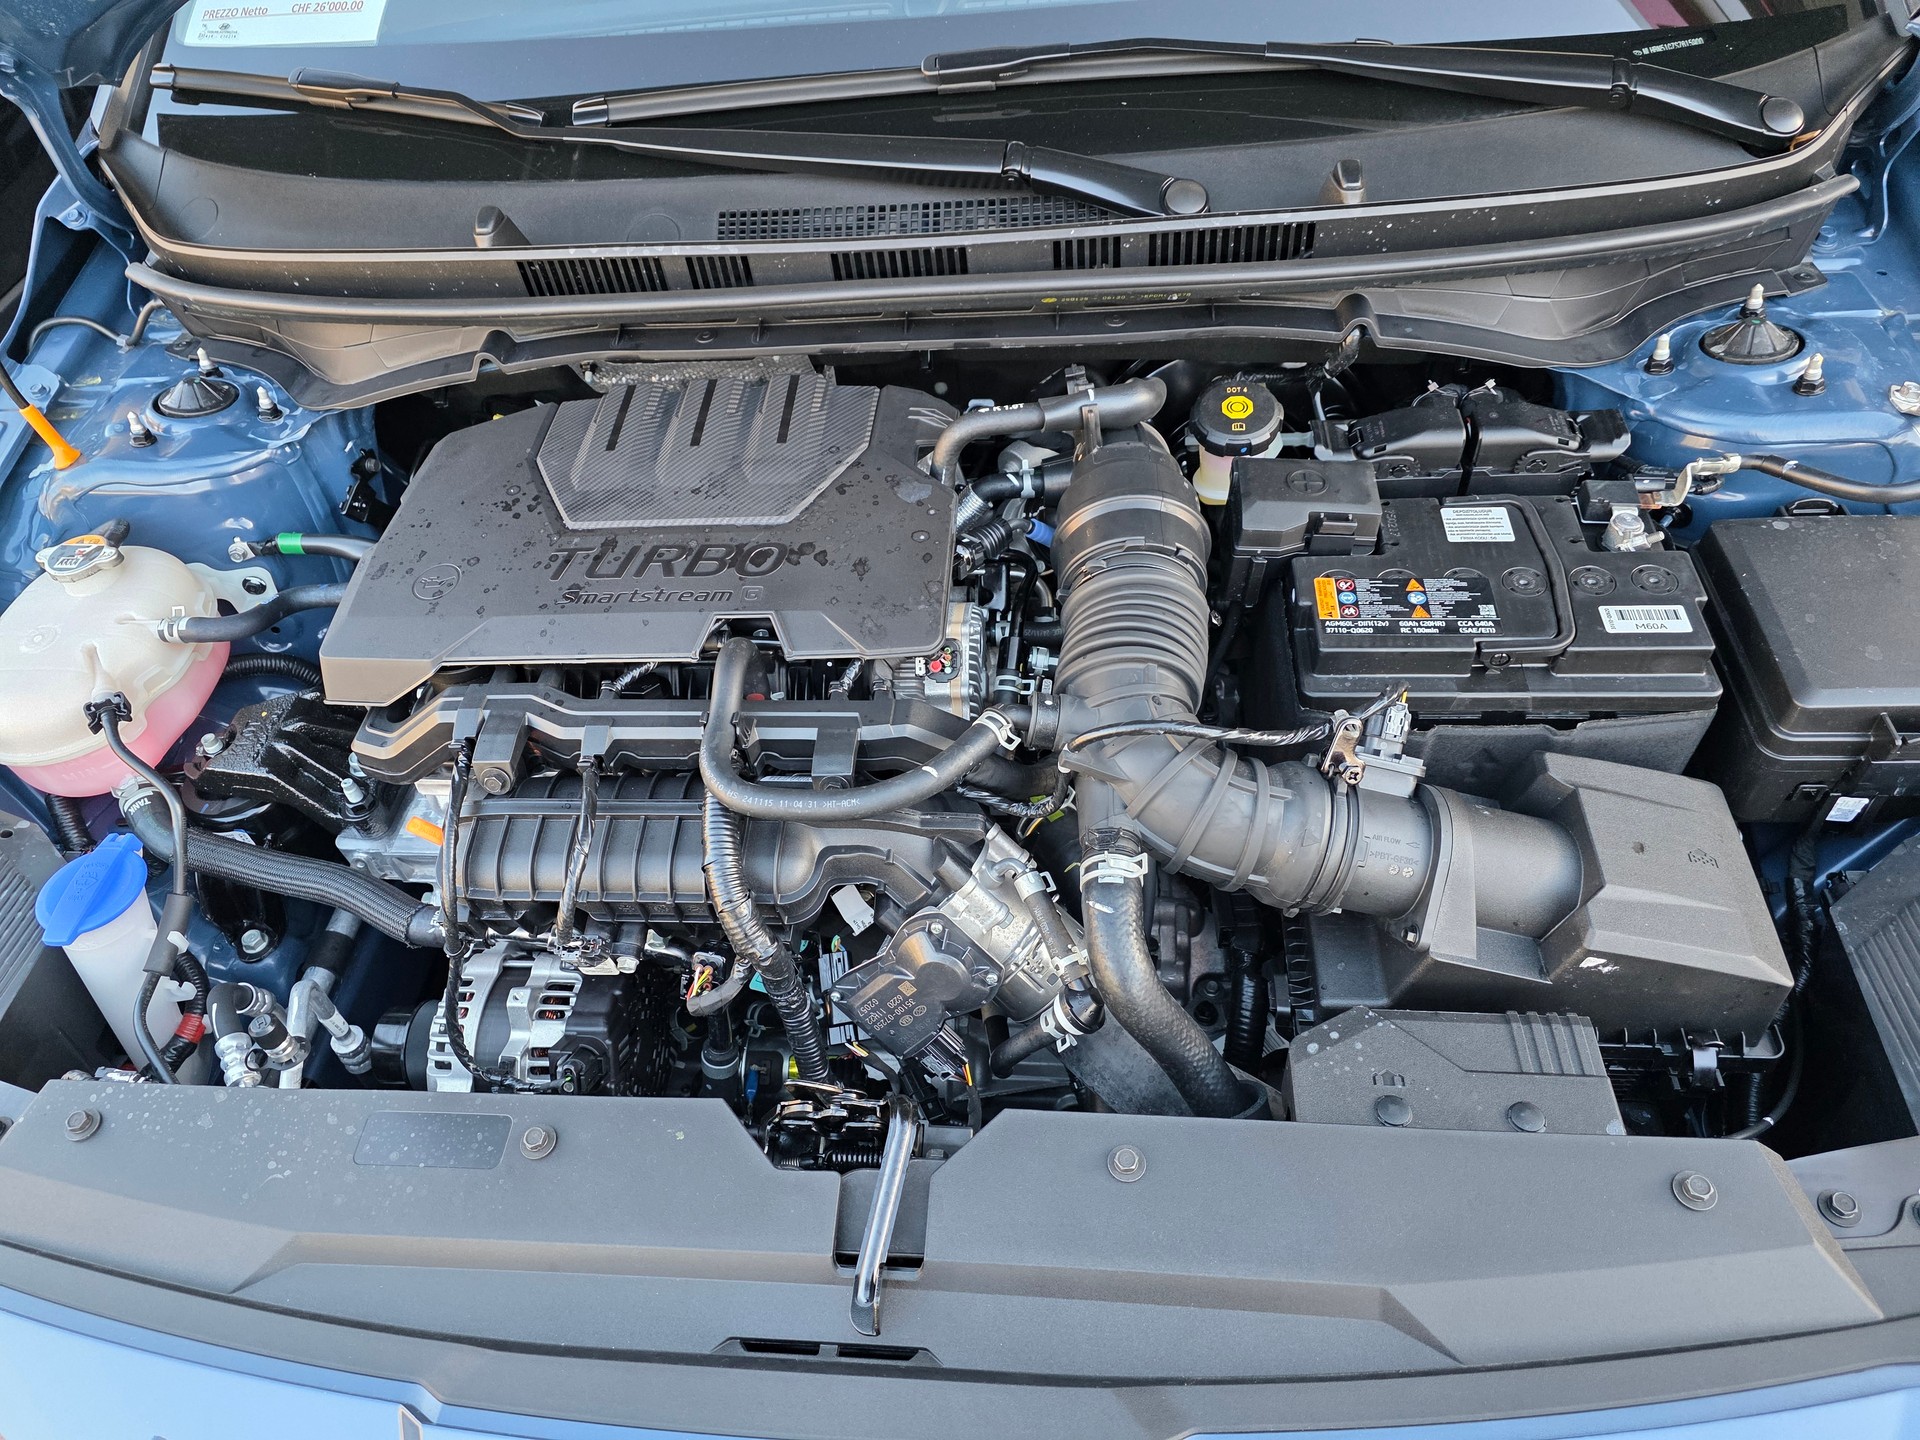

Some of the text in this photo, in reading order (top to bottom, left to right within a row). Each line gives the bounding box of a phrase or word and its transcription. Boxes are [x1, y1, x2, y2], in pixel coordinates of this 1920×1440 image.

[203, 1, 363, 19] PREZZO Netto CHF 26'000.00
[549, 542, 789, 582] TURBO
[555, 587, 733, 605] Smartstream
[1635, 622, 1668, 631] M60A
[128, 797, 152, 816] TANK
[742, 796, 774, 808] 241115
[1372, 834, 1401, 845] AIR FLOW
[886, 994, 904, 1009] 6220
[873, 998, 917, 1031] 35100-07250
